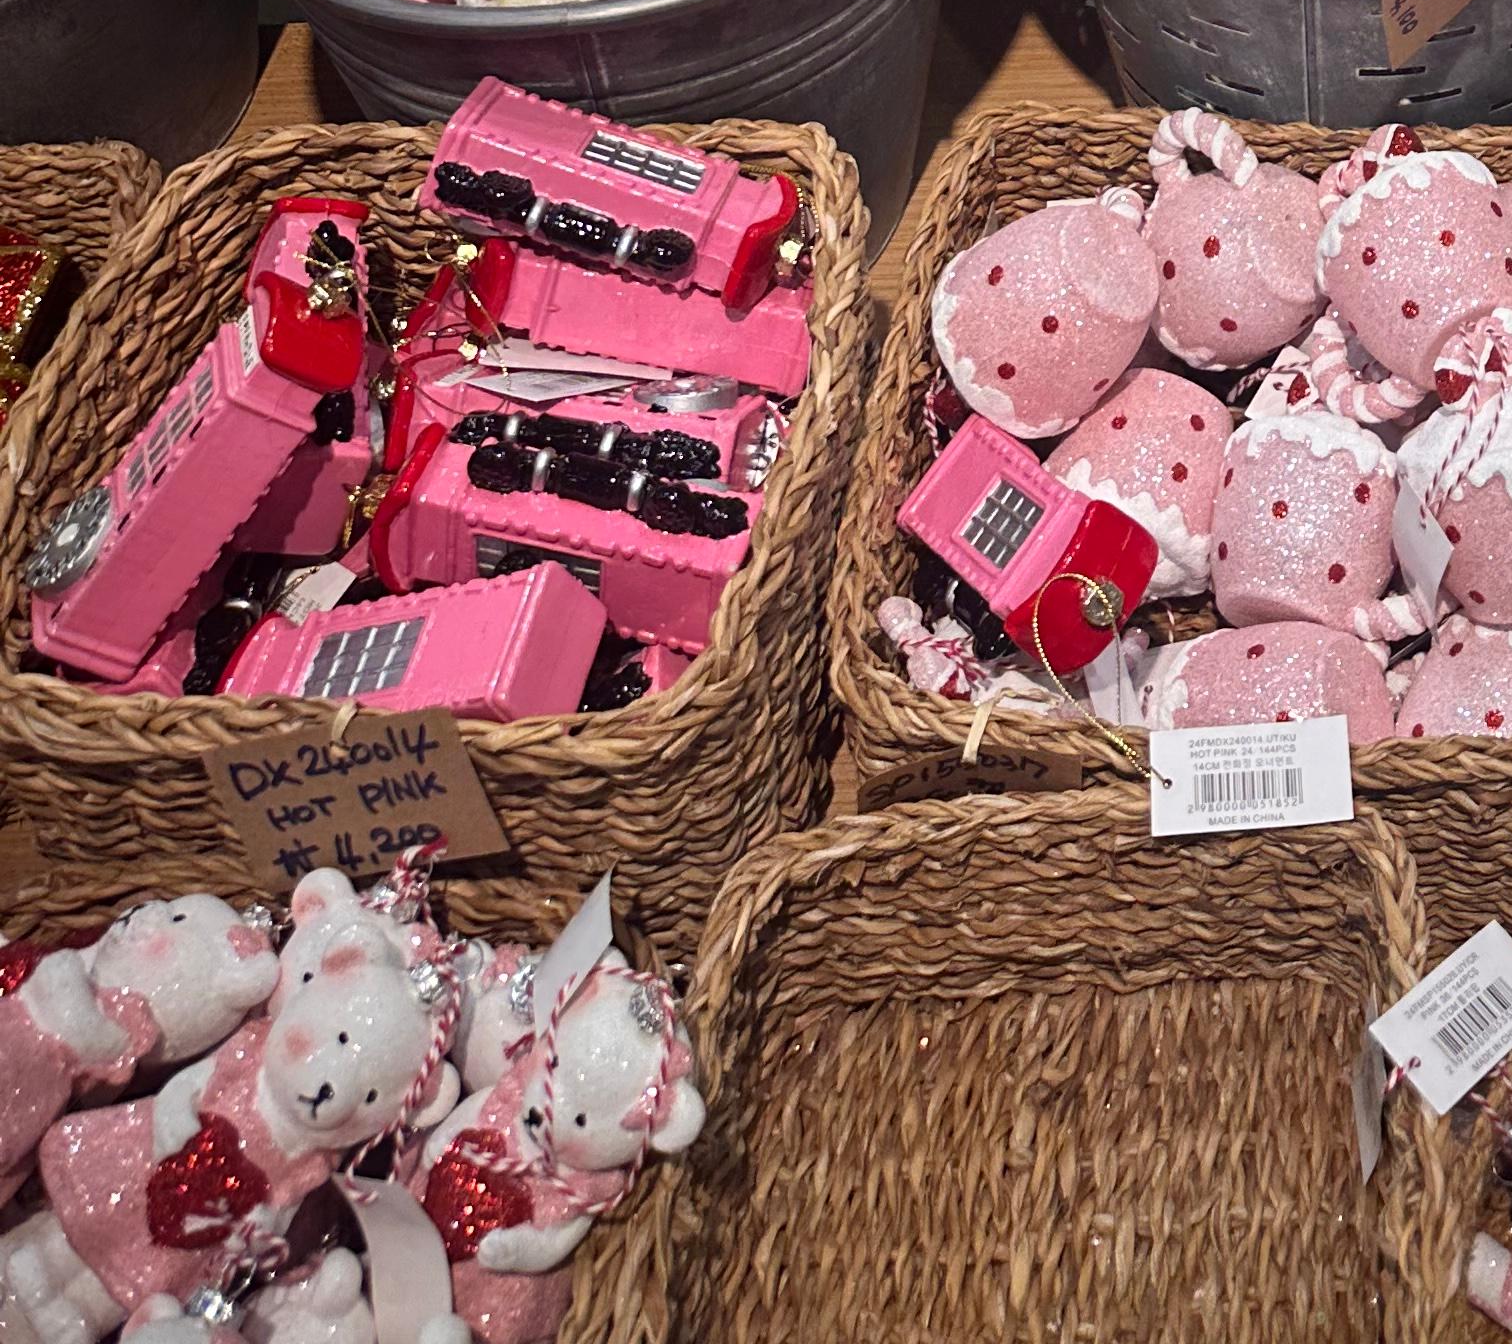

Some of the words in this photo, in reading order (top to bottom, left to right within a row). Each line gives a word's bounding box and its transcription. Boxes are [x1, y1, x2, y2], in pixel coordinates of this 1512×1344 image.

[1190, 749, 1212, 760] HOT
[1213, 747, 1238, 758] PINK
[1193, 761, 1220, 772] 14CM
[266, 795, 337, 832] HOT
[357, 769, 448, 815] PINK
[1208, 815, 1238, 826] MADE
[1240, 814, 1251, 824] IN
[1253, 812, 1286, 823] CHINA
[1471, 1048, 1496, 1072] MADE
